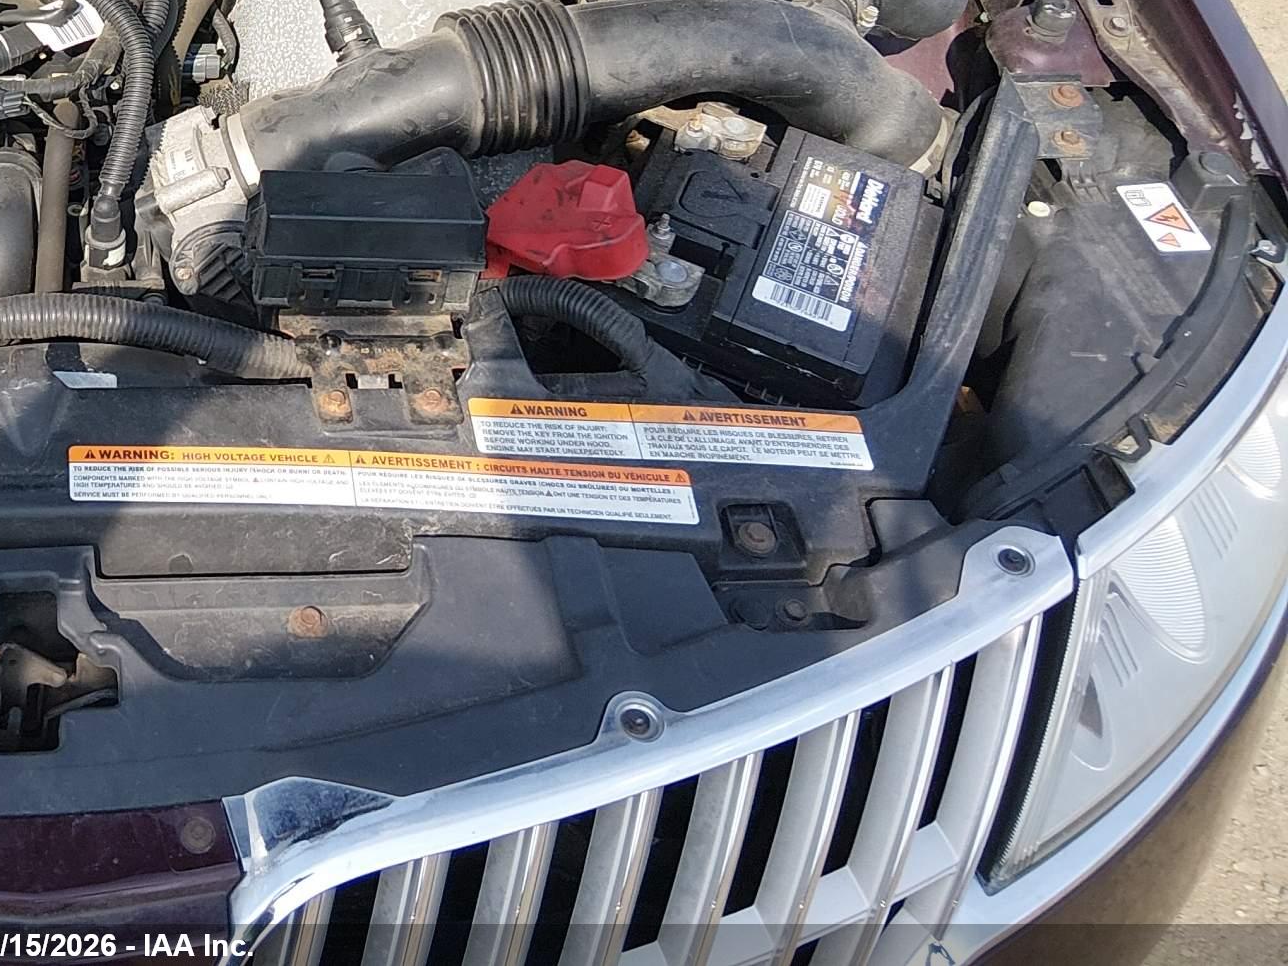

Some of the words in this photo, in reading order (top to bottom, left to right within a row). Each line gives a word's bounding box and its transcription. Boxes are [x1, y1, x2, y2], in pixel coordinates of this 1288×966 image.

[856, 178, 884, 224] DieHard
[524, 405, 588, 417] WARNING
[699, 411, 807, 427] AVERTISSEMENT
[98, 449, 174, 460] WARNING:
[182, 452, 210, 460] HIGH
[215, 453, 266, 461] VOLTAGE
[269, 454, 319, 463] VEHICLE
[372, 456, 472, 470] AVERTISSEMENT
[484, 464, 527, 473] CIRCUITS
[530, 467, 561, 476] HAUTE
[563, 469, 605, 478] TENSION
